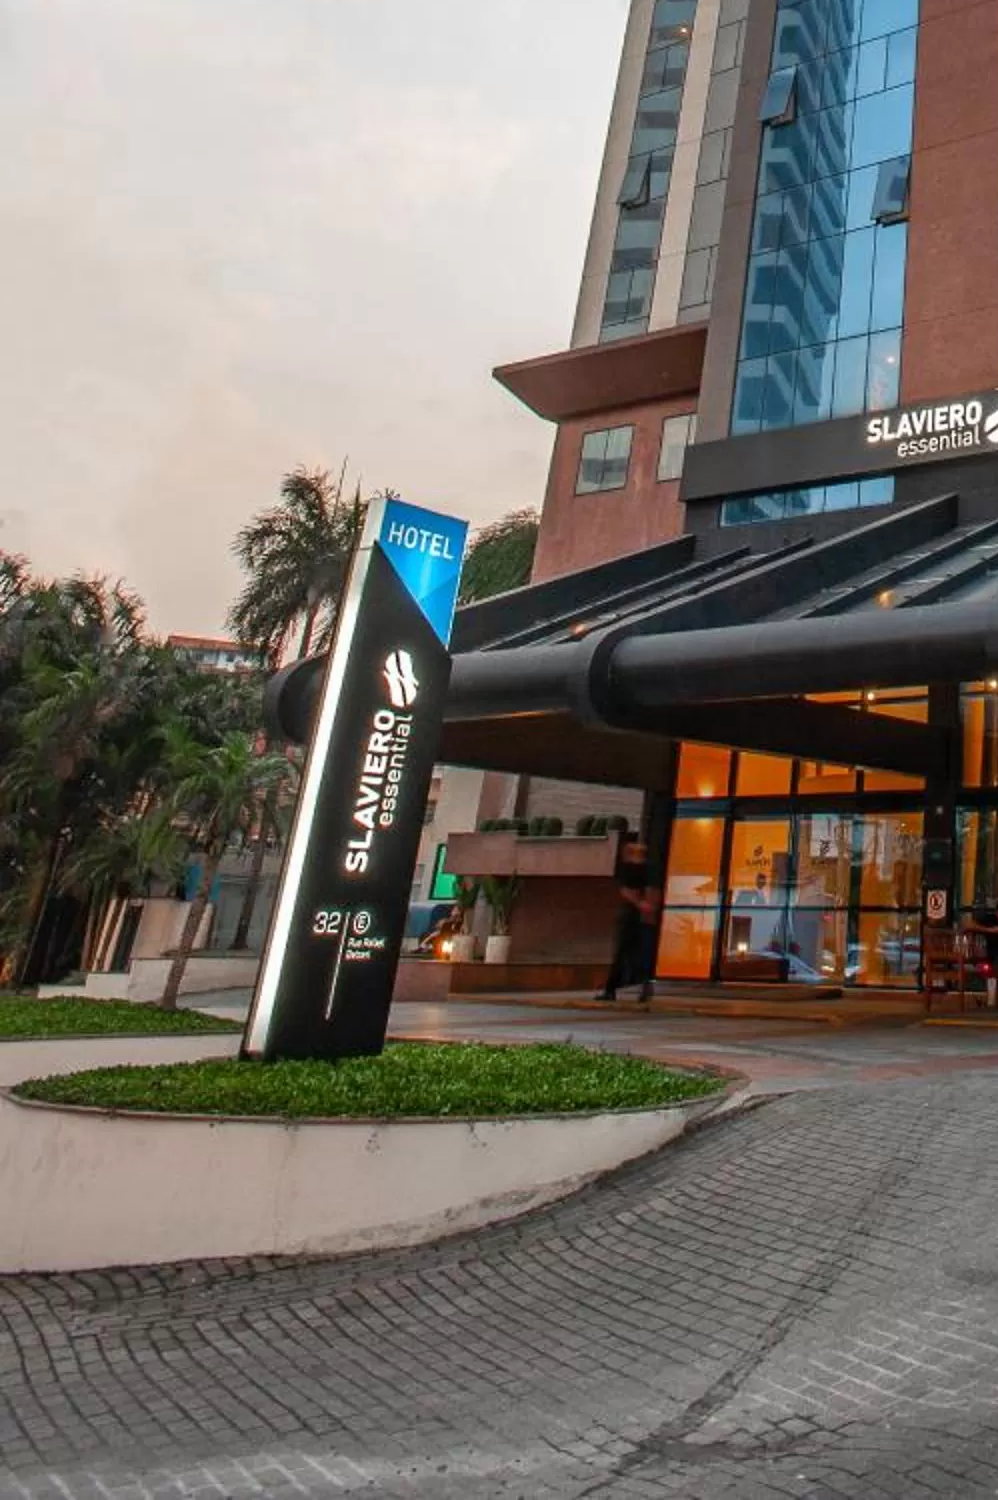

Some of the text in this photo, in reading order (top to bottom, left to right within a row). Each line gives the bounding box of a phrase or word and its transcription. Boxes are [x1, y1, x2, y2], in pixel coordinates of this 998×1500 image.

[866, 401, 983, 443] SLAVIERO
[897, 424, 981, 457] essential
[388, 521, 455, 560] HOTEL
[379, 713, 413, 828] essential
[344, 709, 395, 873] SLAVIERO
[313, 911, 341, 933] 32
